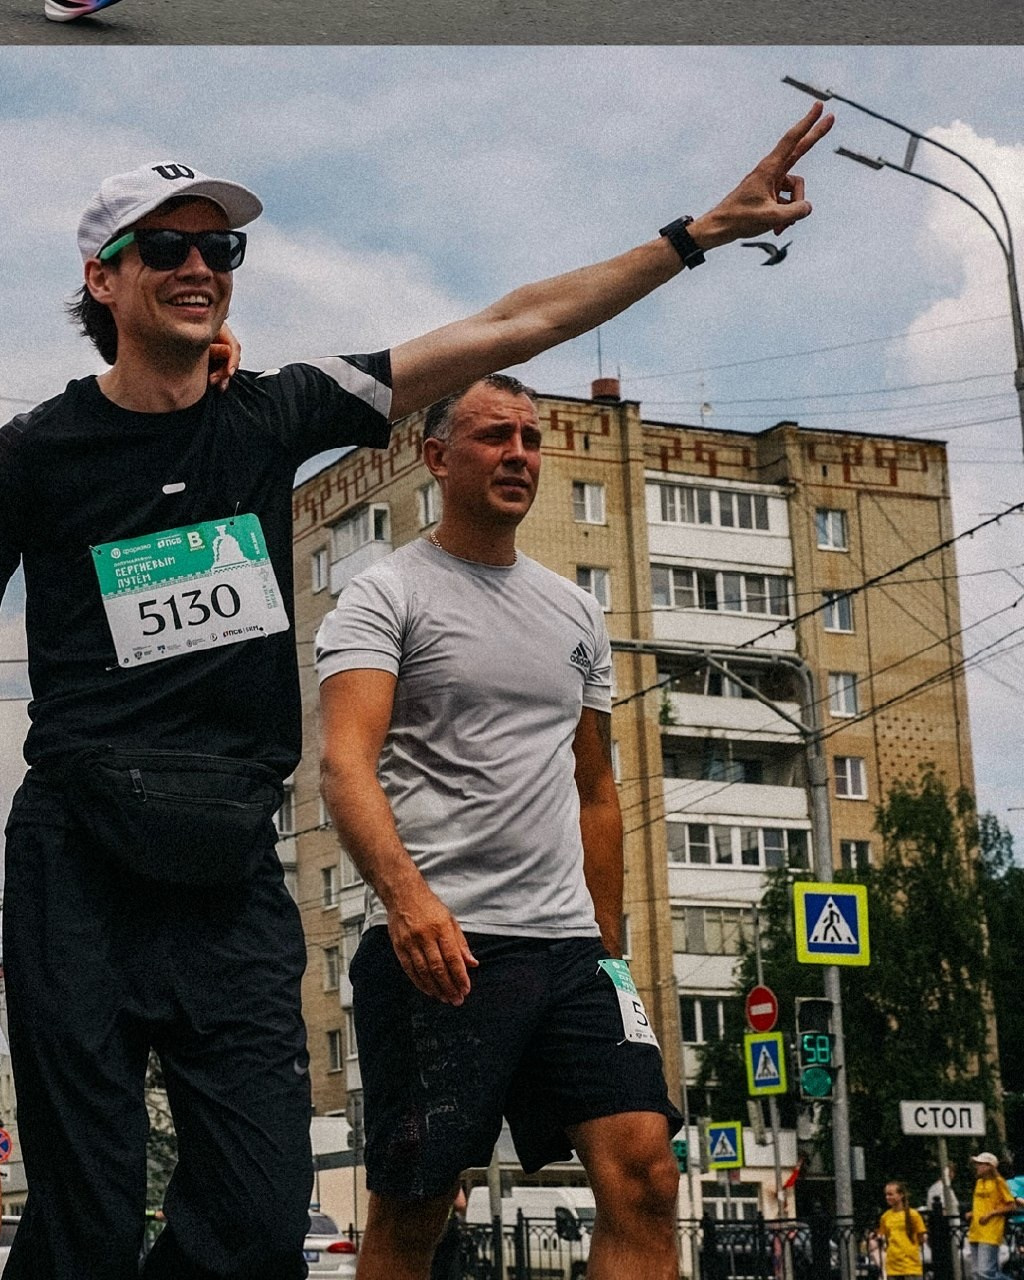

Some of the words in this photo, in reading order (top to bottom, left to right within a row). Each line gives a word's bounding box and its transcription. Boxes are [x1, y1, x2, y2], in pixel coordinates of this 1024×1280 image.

[138, 583, 241, 637] 5130
[803, 1035, 829, 1062] 58
[914, 1106, 972, 1129] СТОП
